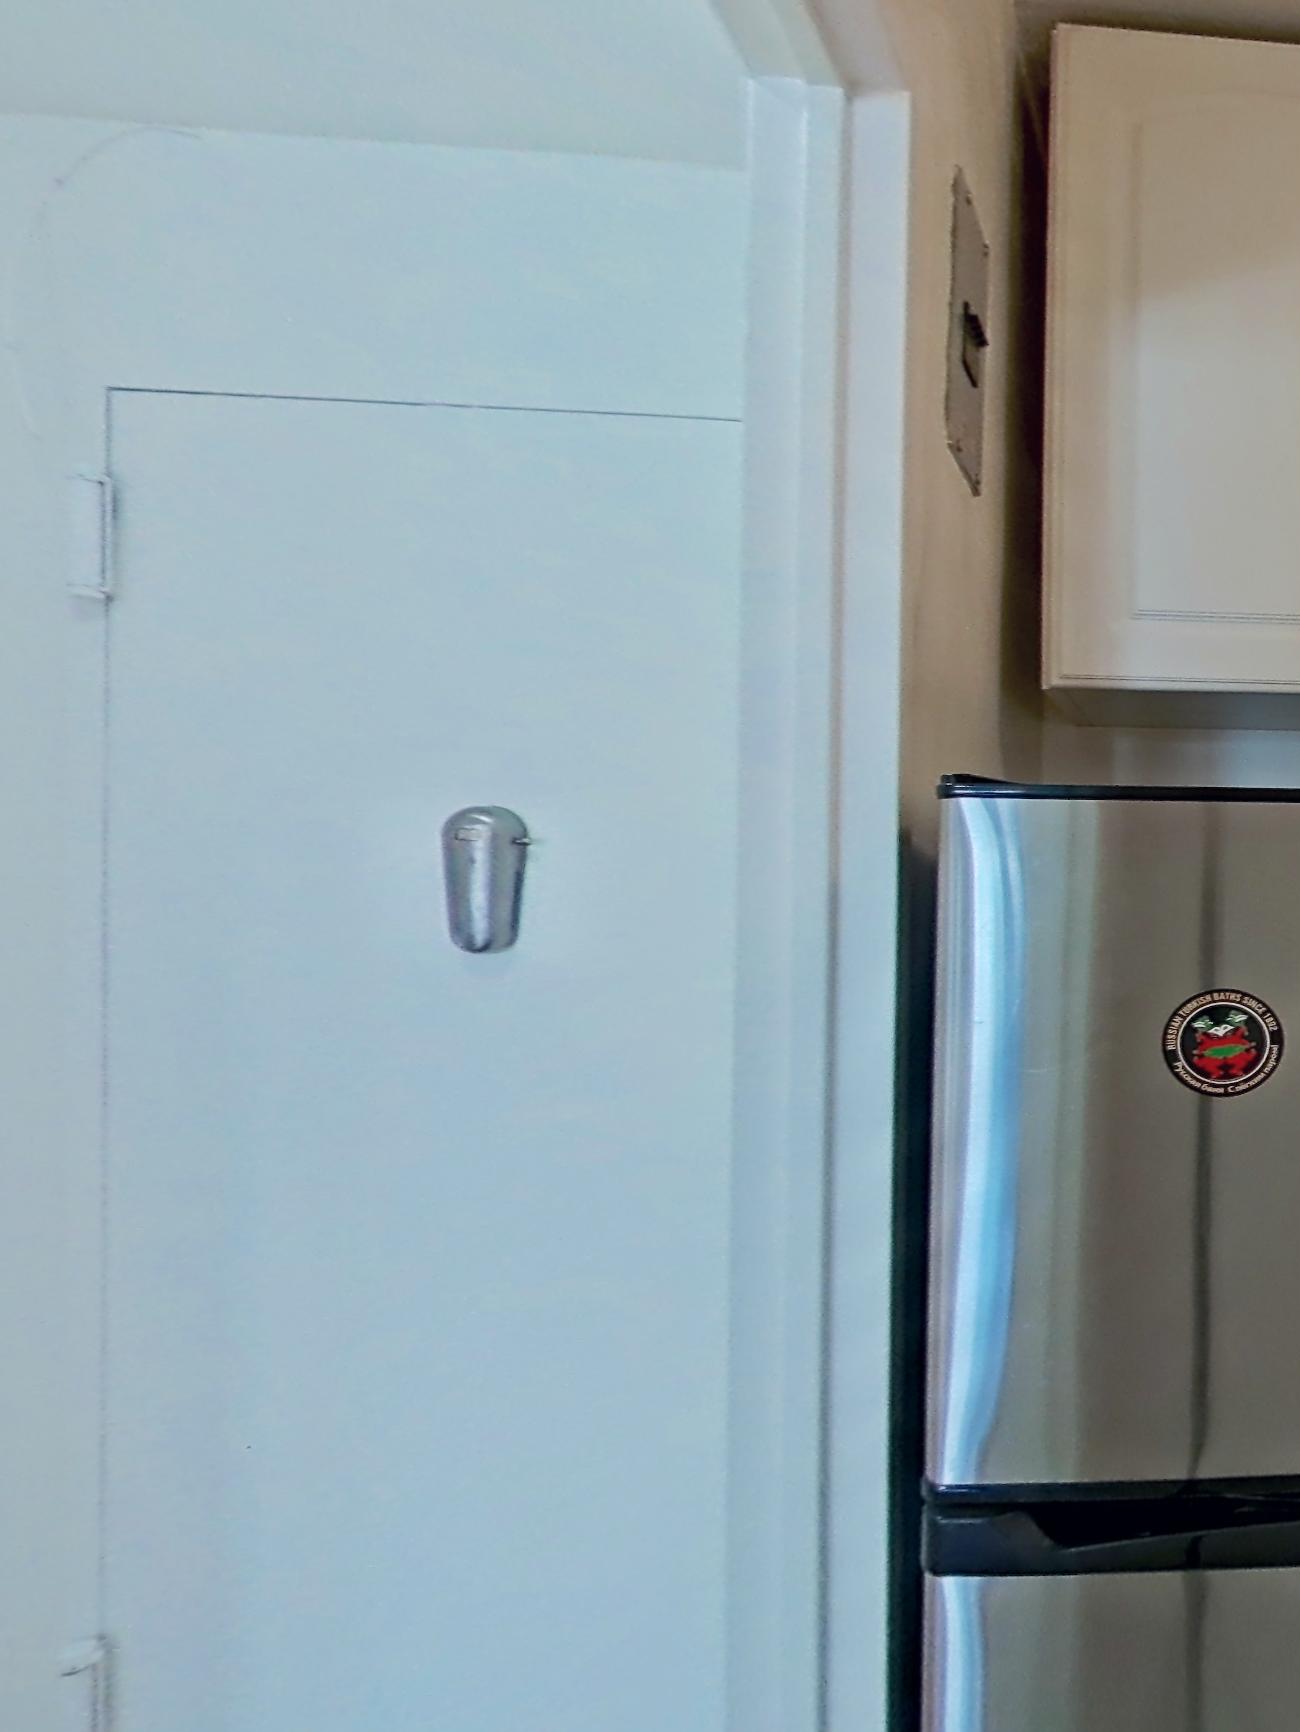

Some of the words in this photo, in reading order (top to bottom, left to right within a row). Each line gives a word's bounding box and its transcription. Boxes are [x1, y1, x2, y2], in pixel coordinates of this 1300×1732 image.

[1165, 1016, 1183, 1050] RUSSIAN
[1178, 996, 1212, 1019] TURKISH
[1212, 992, 1242, 1003] BATHS
[1241, 996, 1267, 1017] SINCE
